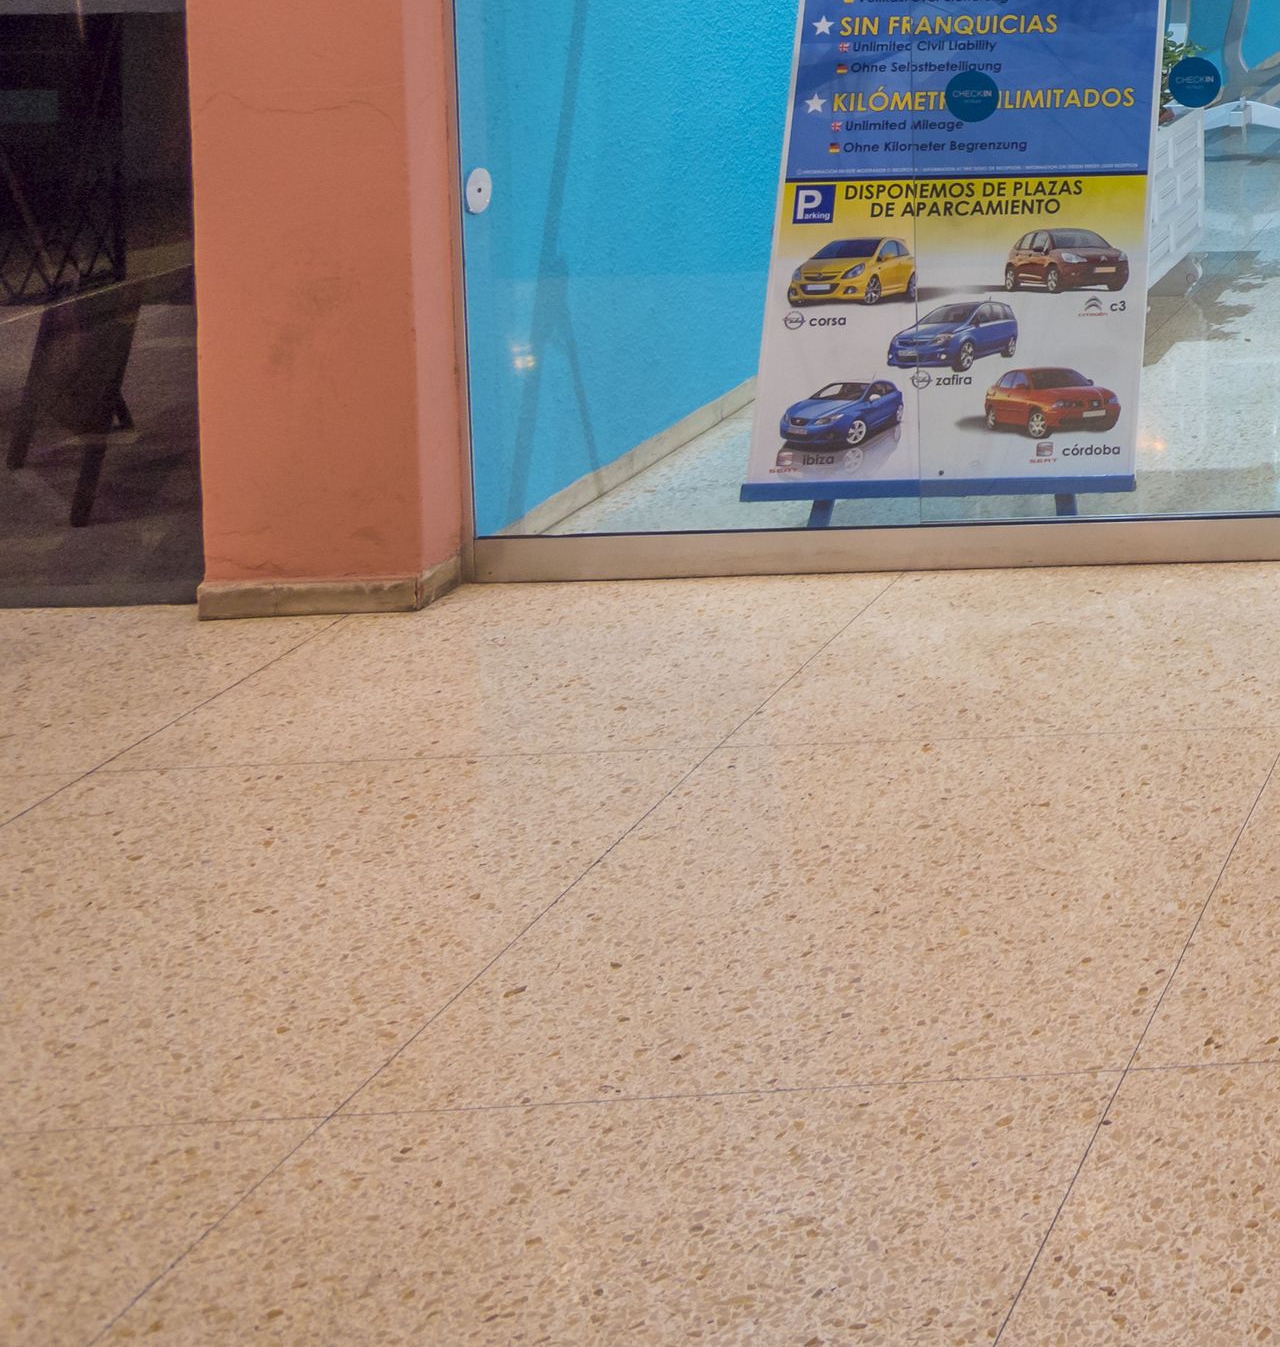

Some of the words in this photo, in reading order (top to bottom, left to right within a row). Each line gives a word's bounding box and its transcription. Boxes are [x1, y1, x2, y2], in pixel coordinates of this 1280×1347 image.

[838, 16, 880, 37] SIN
[887, 13, 1059, 36] FRANQUICIAS
[852, 41, 912, 52] Unlimited
[917, 40, 945, 52] Civil
[949, 39, 997, 52] Liability
[850, 62, 887, 73] Ohne
[831, 85, 946, 112] KILÓMET
[845, 120, 906, 131] Unlimited
[911, 119, 964, 132] Mileage
[843, 142, 879, 153] Ohne
[884, 141, 945, 152] Kilometer
[949, 140, 1028, 153] Begrenzung
[844, 182, 976, 200] DISPONEMOS
[982, 182, 1007, 198] DE
[1012, 179, 1084, 198] PLAZAS
[870, 202, 896, 218] DE
[900, 199, 1061, 217] APARCAMIENTO
[1110, 300, 1127, 312] c3
[809, 316, 847, 327] corsa
[935, 374, 973, 387] zafira
[1062, 442, 1121, 457] córdoba
[802, 453, 835, 466] ibiza
